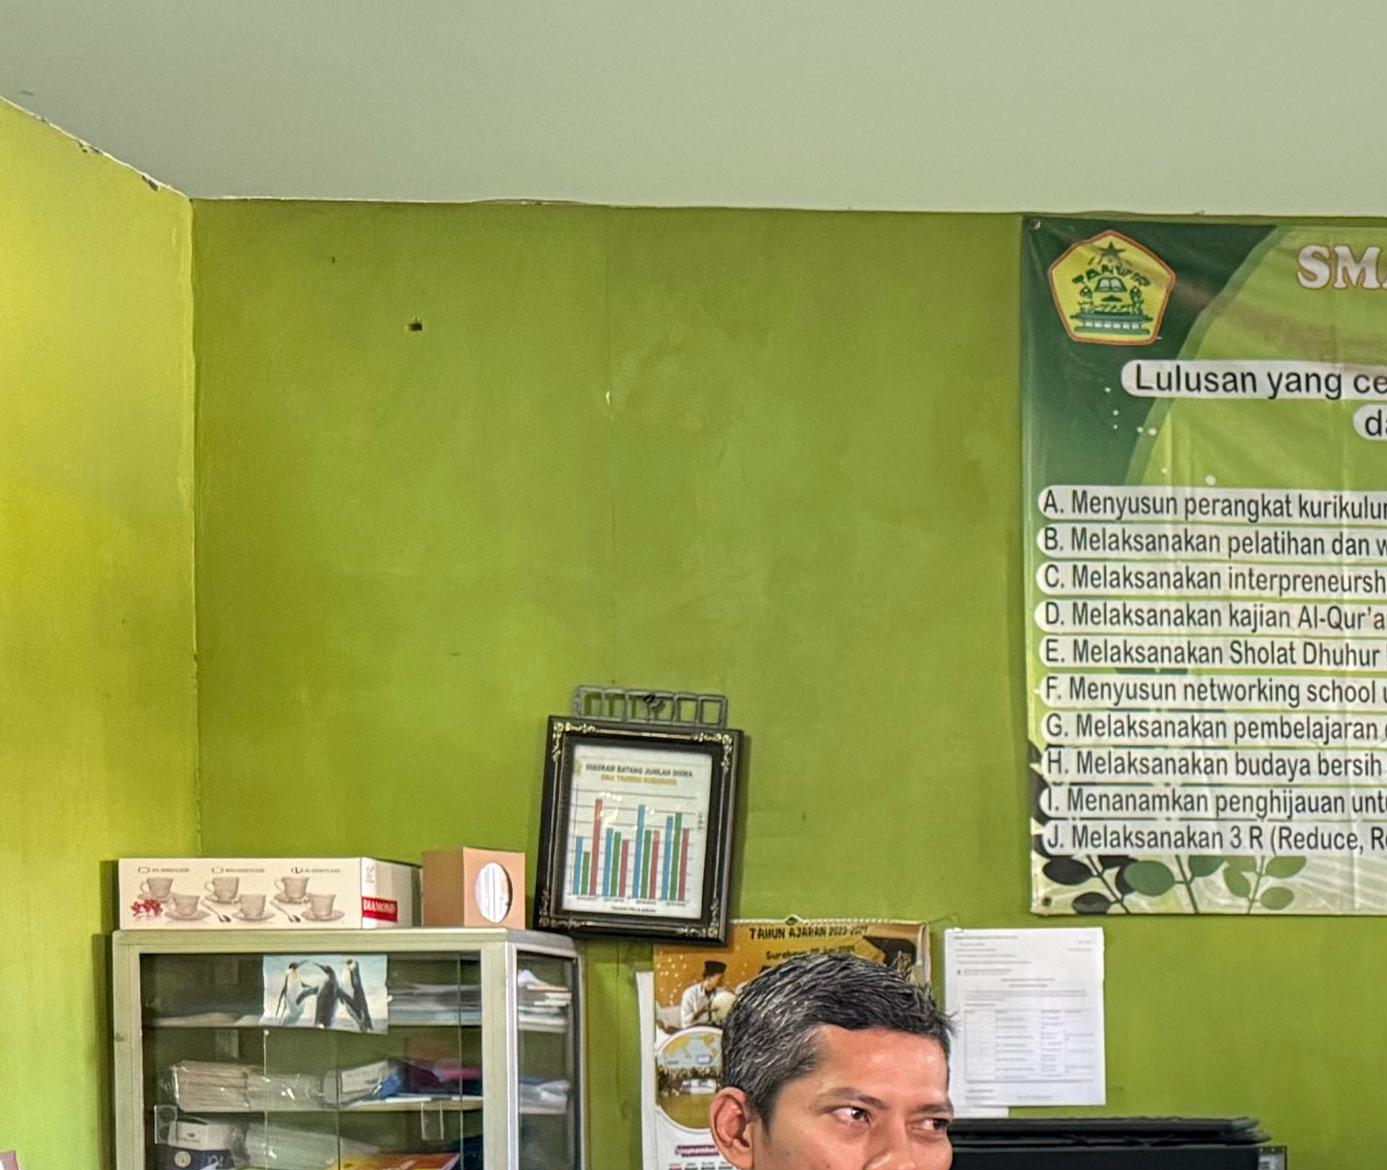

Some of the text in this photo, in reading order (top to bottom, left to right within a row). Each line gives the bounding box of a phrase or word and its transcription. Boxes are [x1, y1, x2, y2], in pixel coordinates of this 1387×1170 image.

[1134, 364, 1257, 397] Lulusan
[1266, 371, 1342, 400] yang
[1043, 491, 1065, 514] A.
[1071, 490, 1178, 519] Menyusun
[1184, 495, 1293, 522] perangkat
[1043, 527, 1064, 550] B.
[1071, 528, 1221, 552] Melaksanakan
[1227, 531, 1325, 555] pelatihan
[1331, 532, 1370, 555] dan
[1044, 565, 1065, 588] C.
[1072, 565, 1221, 589] Melaksanakan
[1045, 602, 1065, 624] D.
[1072, 602, 1222, 626] Melaksanakan
[1228, 604, 1291, 632] kajian
[1045, 639, 1065, 662] E.
[1073, 640, 1223, 664] Melaksanakan
[1229, 640, 1297, 664] Sholat
[1303, 642, 1381, 666] Dhuhur
[1046, 676, 1062, 699] F.
[1069, 677, 1177, 705] Menyusun
[1183, 678, 1301, 707] networking
[1306, 680, 1376, 703] school
[1046, 713, 1069, 738] G.
[1076, 714, 1227, 737] Melaksanakan
[1233, 717, 1378, 744] pembelajaran
[1046, 752, 1069, 775] H.
[1076, 751, 1228, 774] Melaksanakan
[1235, 753, 1312, 781] budaya
[1317, 753, 1382, 776] bersih
[1045, 790, 1060, 812] I.
[1066, 788, 1208, 813] Menanamkan
[1215, 790, 1346, 820] penghijauan
[1047, 826, 1064, 849] J.
[1071, 825, 1224, 848] Melaksanakan
[1229, 826, 1242, 848] 3
[1249, 826, 1264, 848] R
[1270, 826, 1364, 853] (Reduce,
